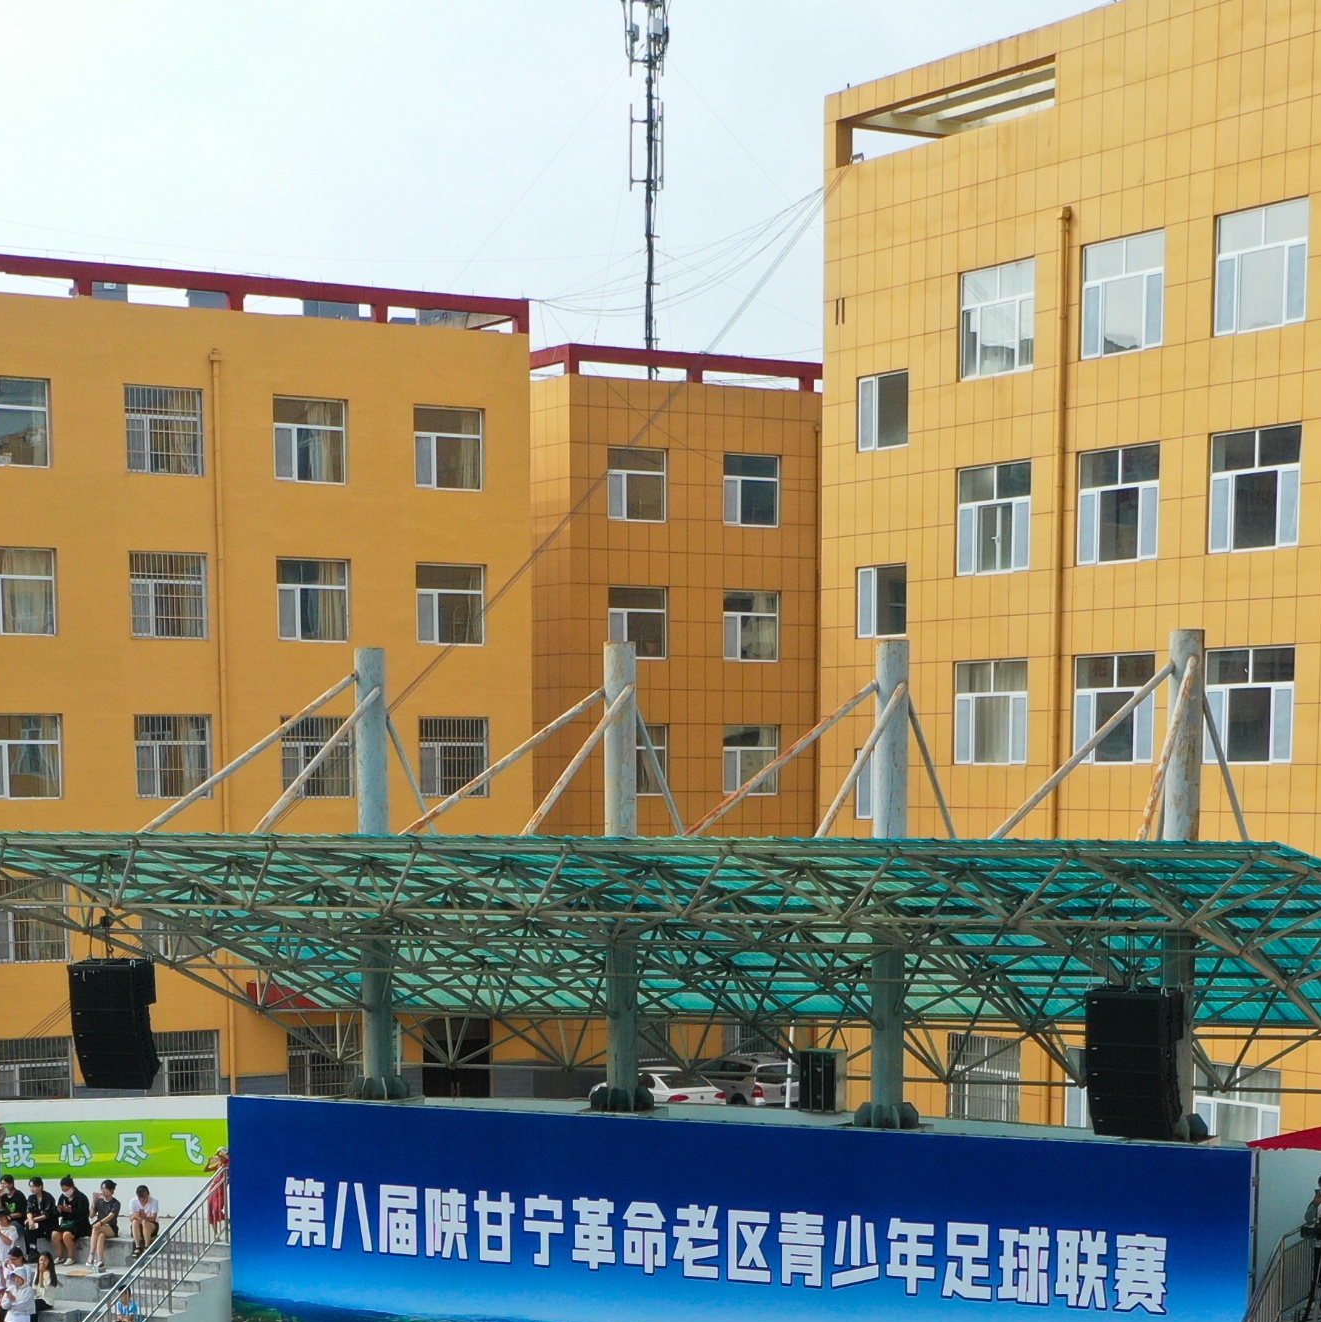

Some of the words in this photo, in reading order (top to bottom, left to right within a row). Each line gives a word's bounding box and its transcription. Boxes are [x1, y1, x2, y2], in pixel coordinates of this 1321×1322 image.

[2, 1131, 205, 1170] 我心尽飞
[284, 1176, 1169, 1315] 第八届陕甘宁革命老区青少年足球联赛
